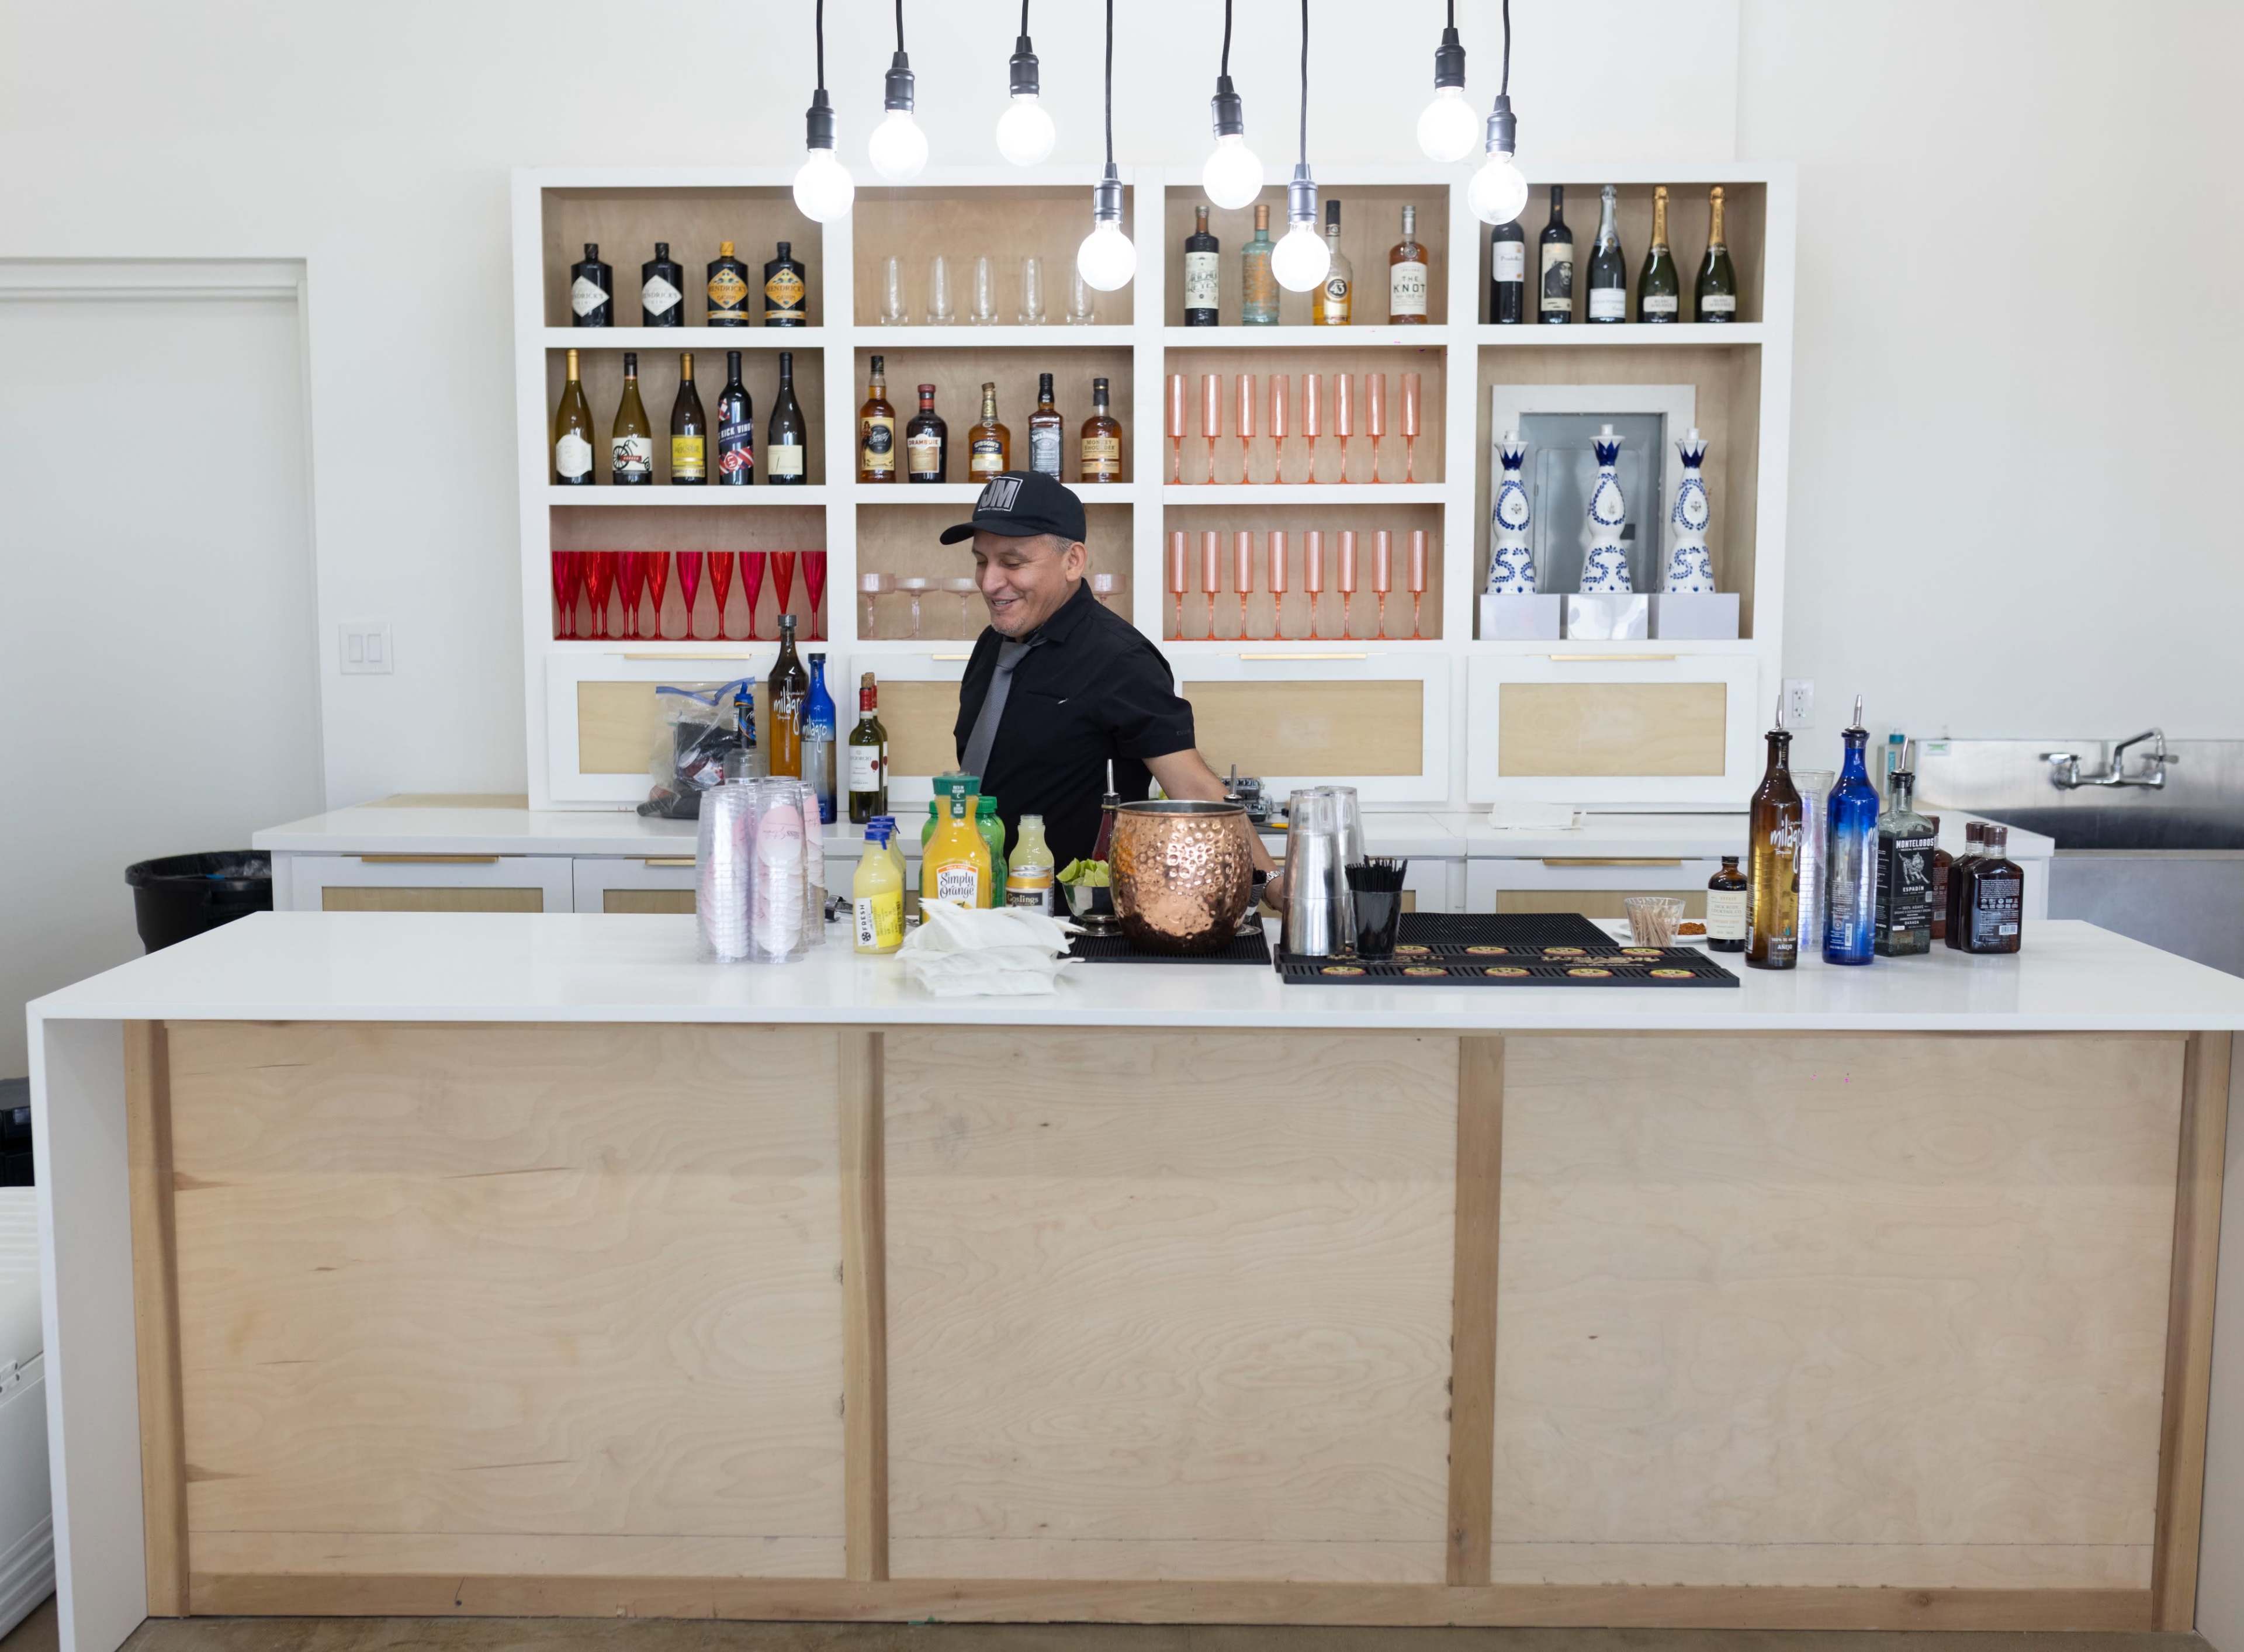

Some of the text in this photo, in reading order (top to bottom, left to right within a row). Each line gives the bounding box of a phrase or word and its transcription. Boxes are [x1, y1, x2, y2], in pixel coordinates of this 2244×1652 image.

[1328, 283, 1345, 296] 43
[1393, 284, 1425, 293] KNOT
[981, 480, 1019, 508] JM
[802, 715, 827, 753] milagro
[1896, 837, 1934, 848] MONTELOBOS
[940, 871, 974, 886] Simply
[940, 885, 974, 899] Orange
[1007, 893, 1038, 905] Goslings
